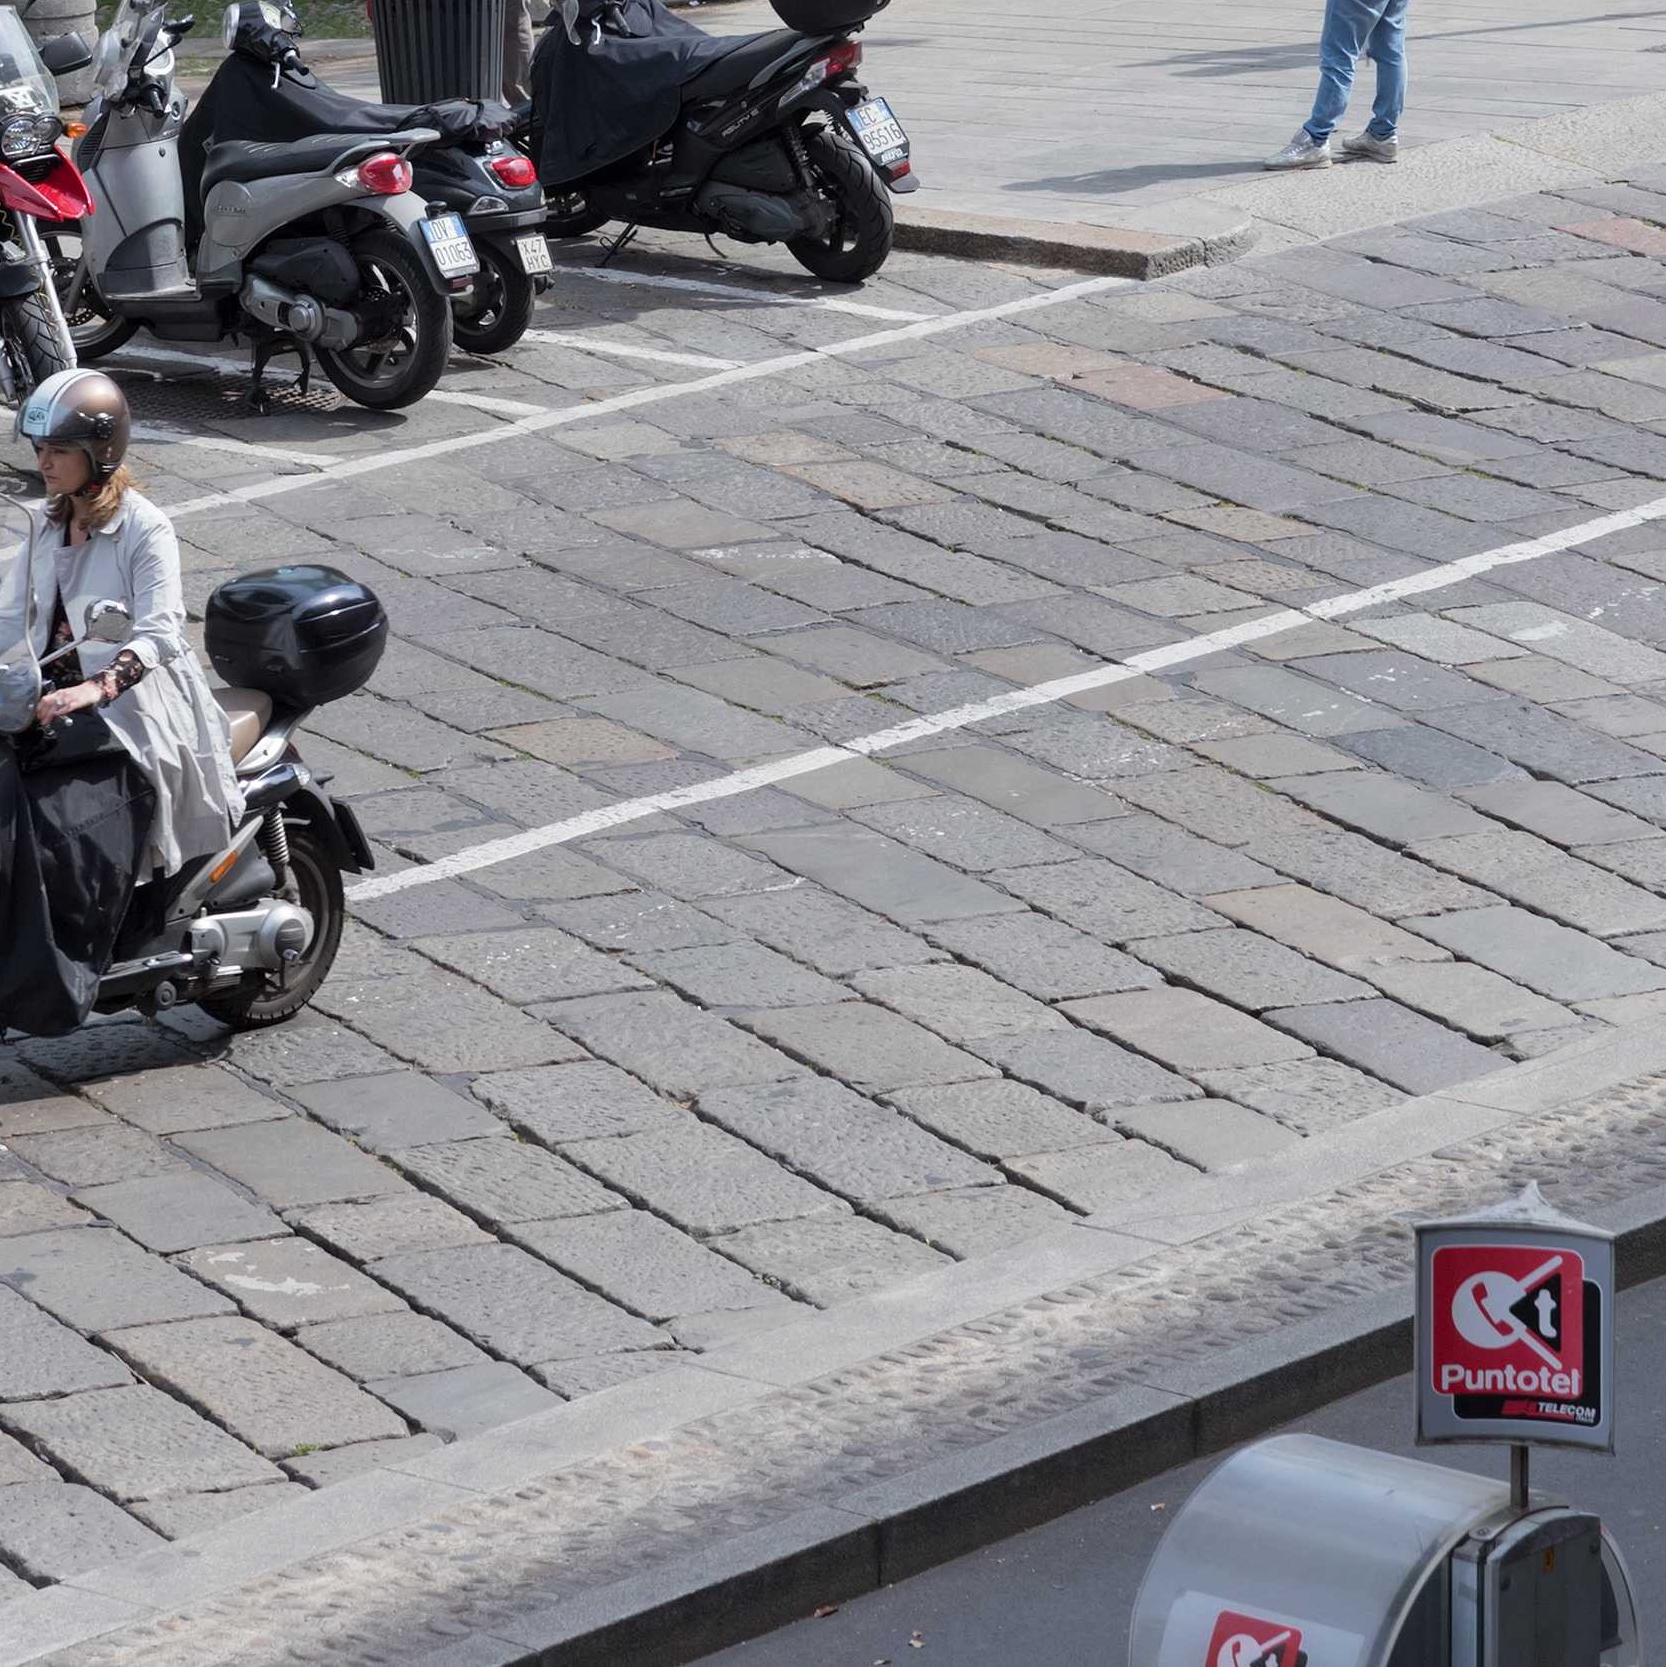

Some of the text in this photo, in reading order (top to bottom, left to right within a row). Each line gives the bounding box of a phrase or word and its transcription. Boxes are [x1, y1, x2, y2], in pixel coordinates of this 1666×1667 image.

[858, 106, 877, 126] EC
[863, 122, 903, 152] 95516
[435, 242, 474, 267] 01063
[1440, 1363, 1582, 1396] Puntotel
[1537, 1401, 1597, 1419] TELECOM
